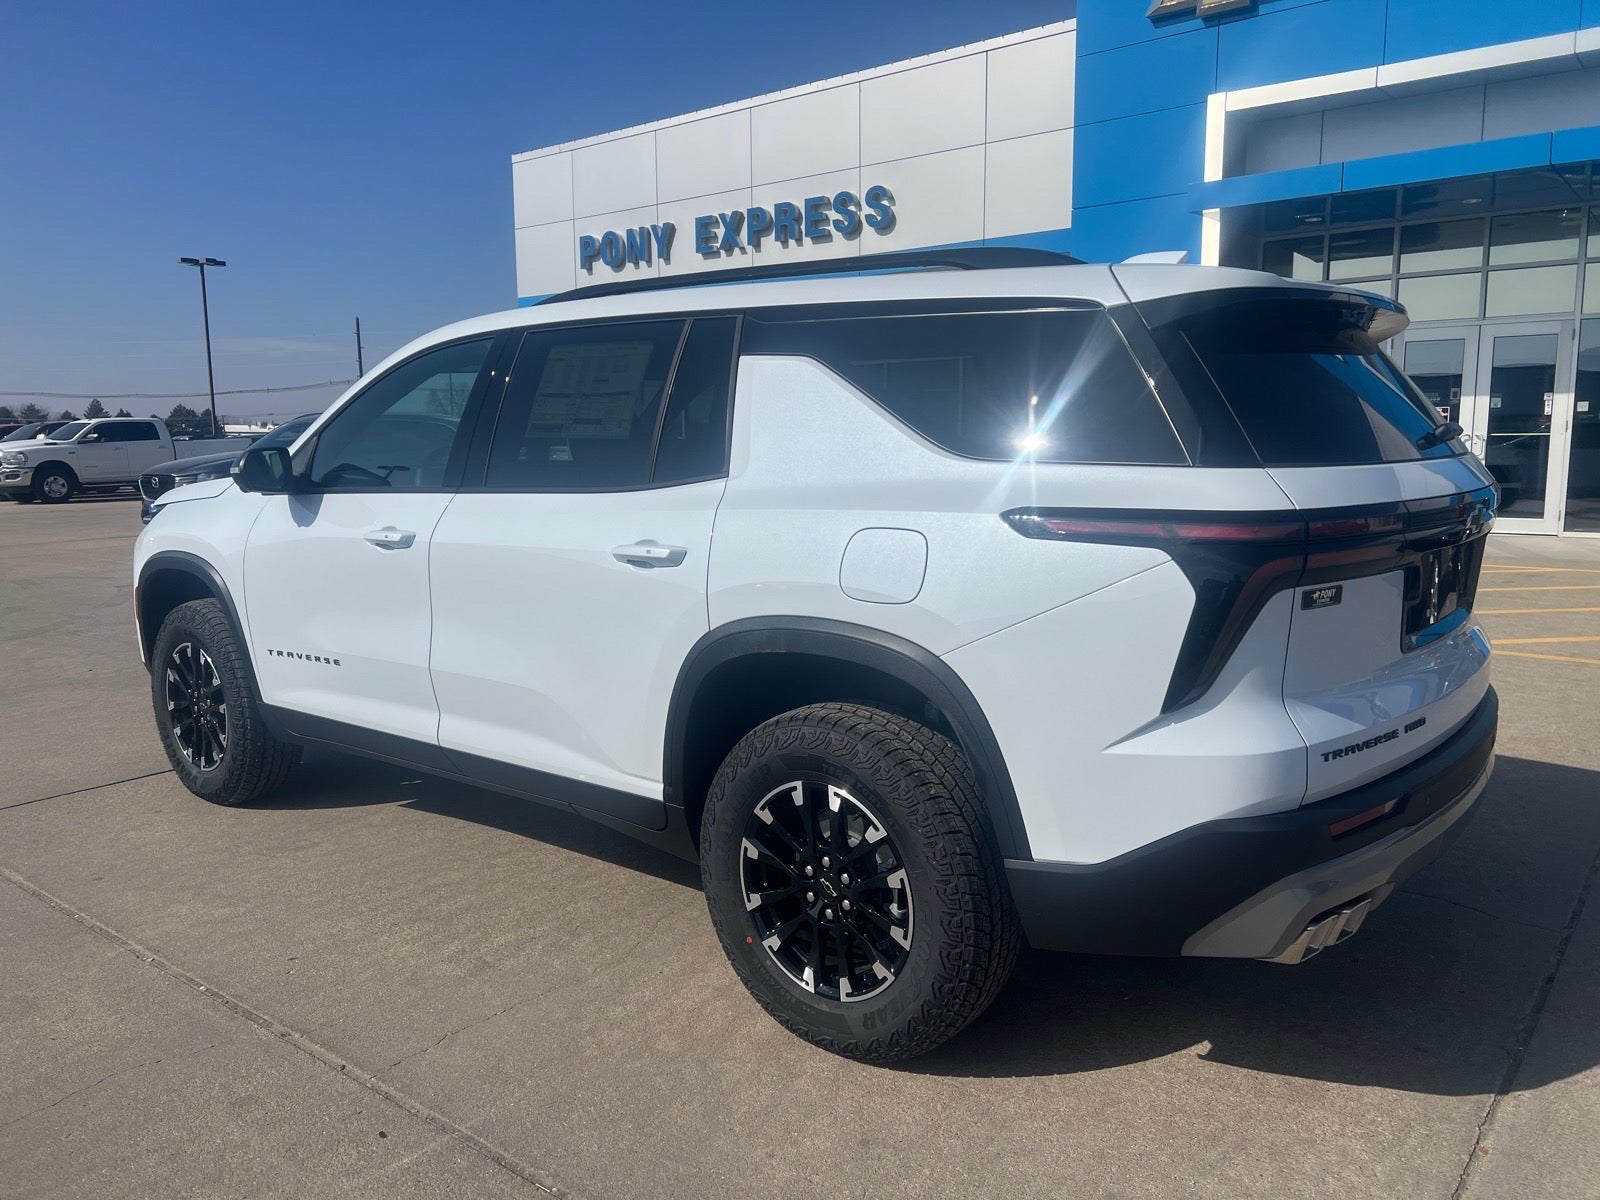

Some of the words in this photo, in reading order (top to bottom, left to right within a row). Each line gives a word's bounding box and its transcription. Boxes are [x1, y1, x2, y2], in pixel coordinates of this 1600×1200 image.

[579, 222, 677, 275] PONY
[694, 184, 897, 260] EXPRESS
[1320, 588, 1337, 598] PONY
[267, 649, 341, 666] TRAVERSE
[1320, 729, 1400, 762] TRAVERSE
